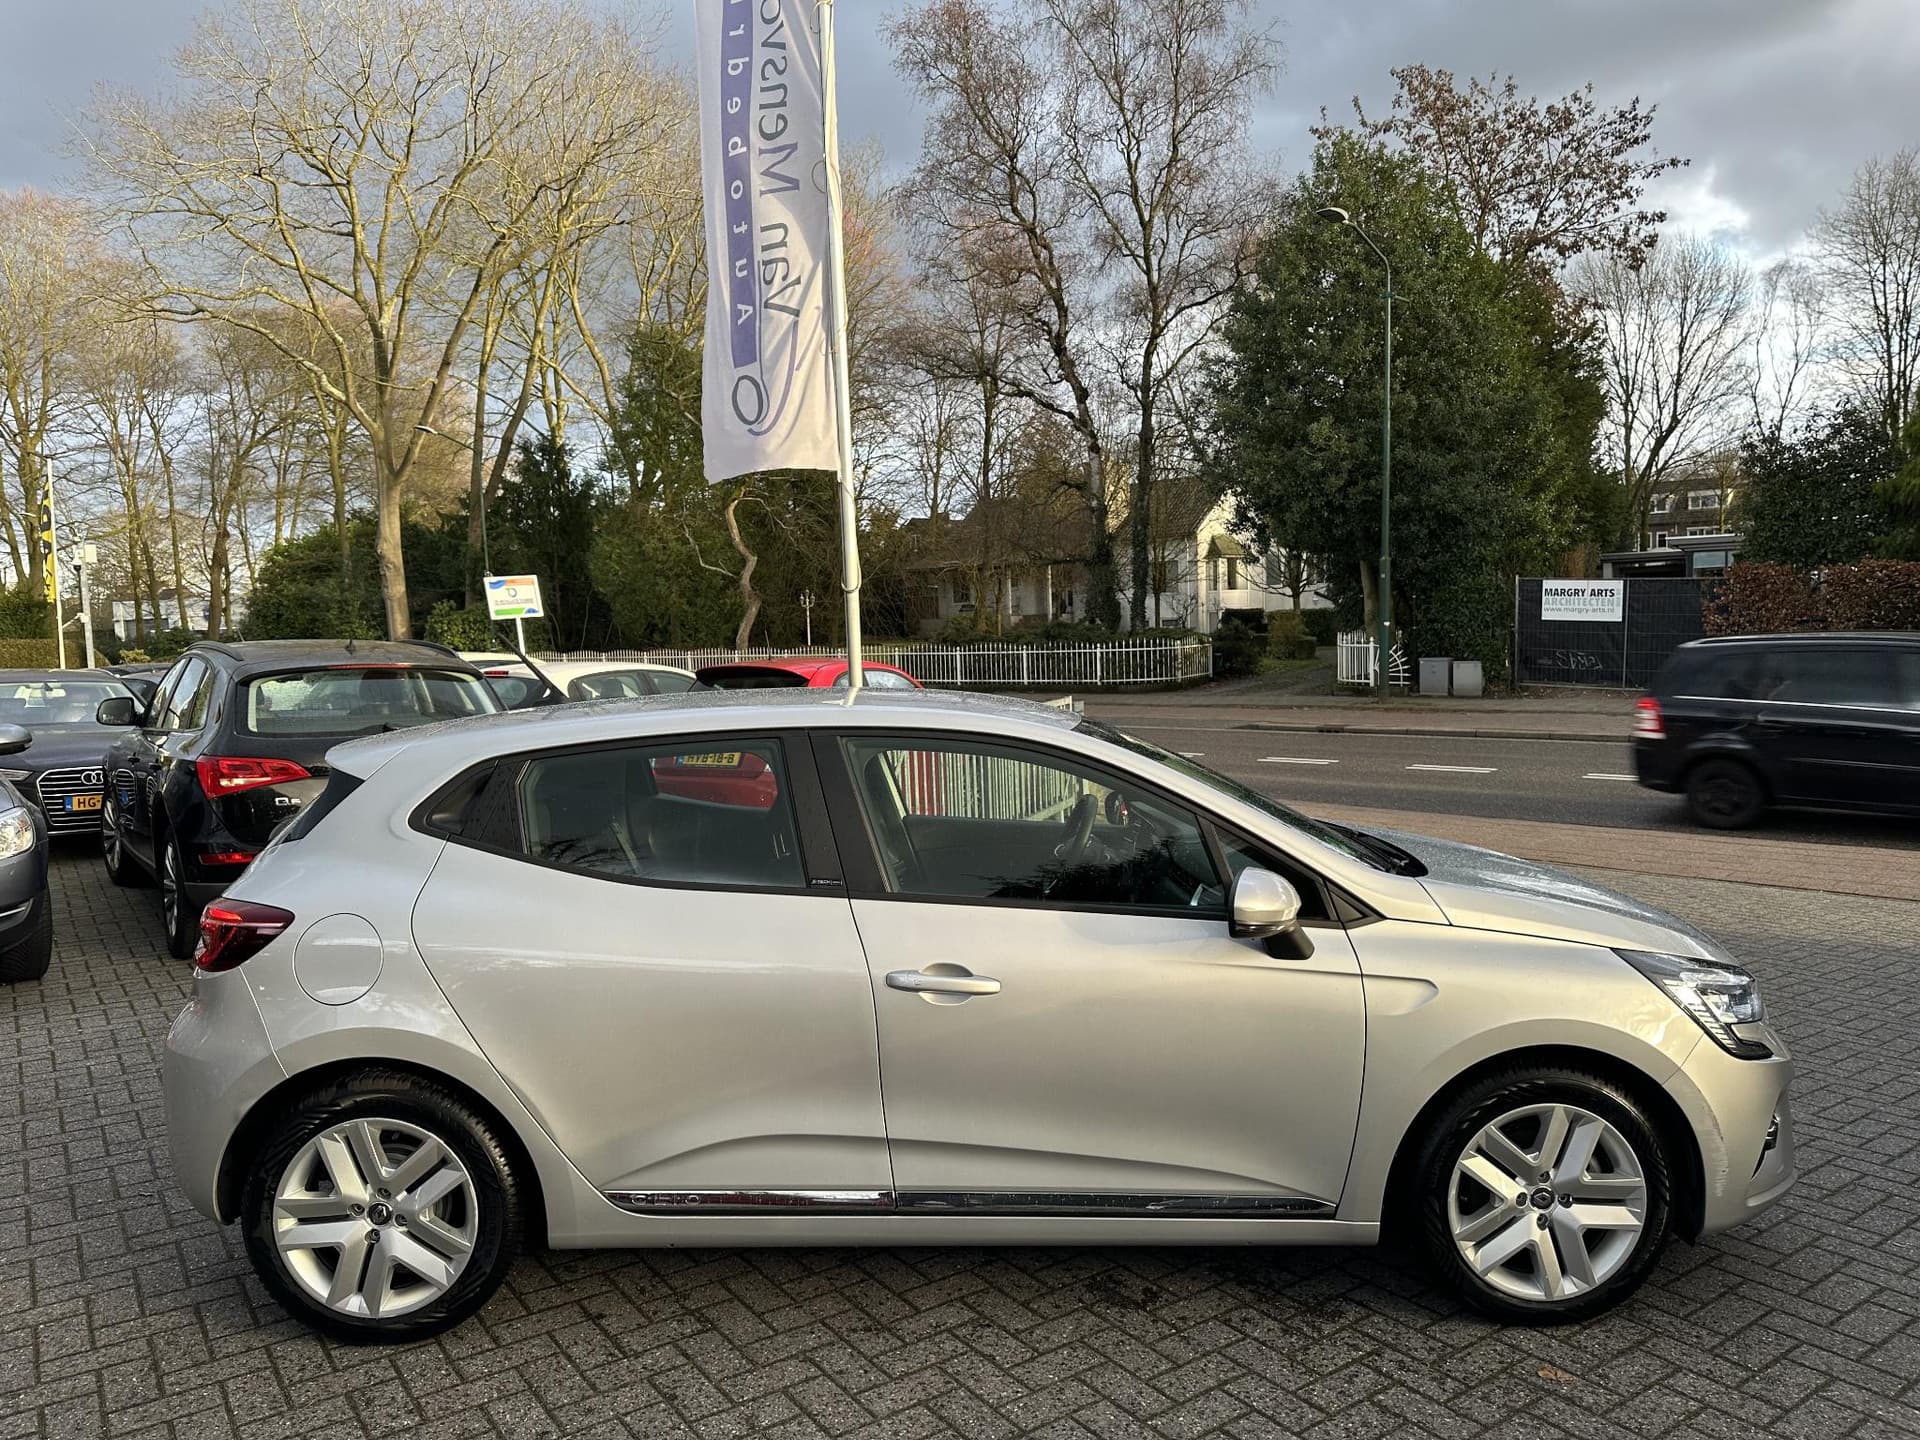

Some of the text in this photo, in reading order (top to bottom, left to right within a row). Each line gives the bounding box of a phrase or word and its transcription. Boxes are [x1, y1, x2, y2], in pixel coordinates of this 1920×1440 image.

[1544, 588, 1587, 598] MARGRY
[1589, 588, 1616, 598] ARTS
[1543, 597, 1615, 607] ARCHITECTEN
[1543, 606, 1616, 614] www.margry-arts.nl
